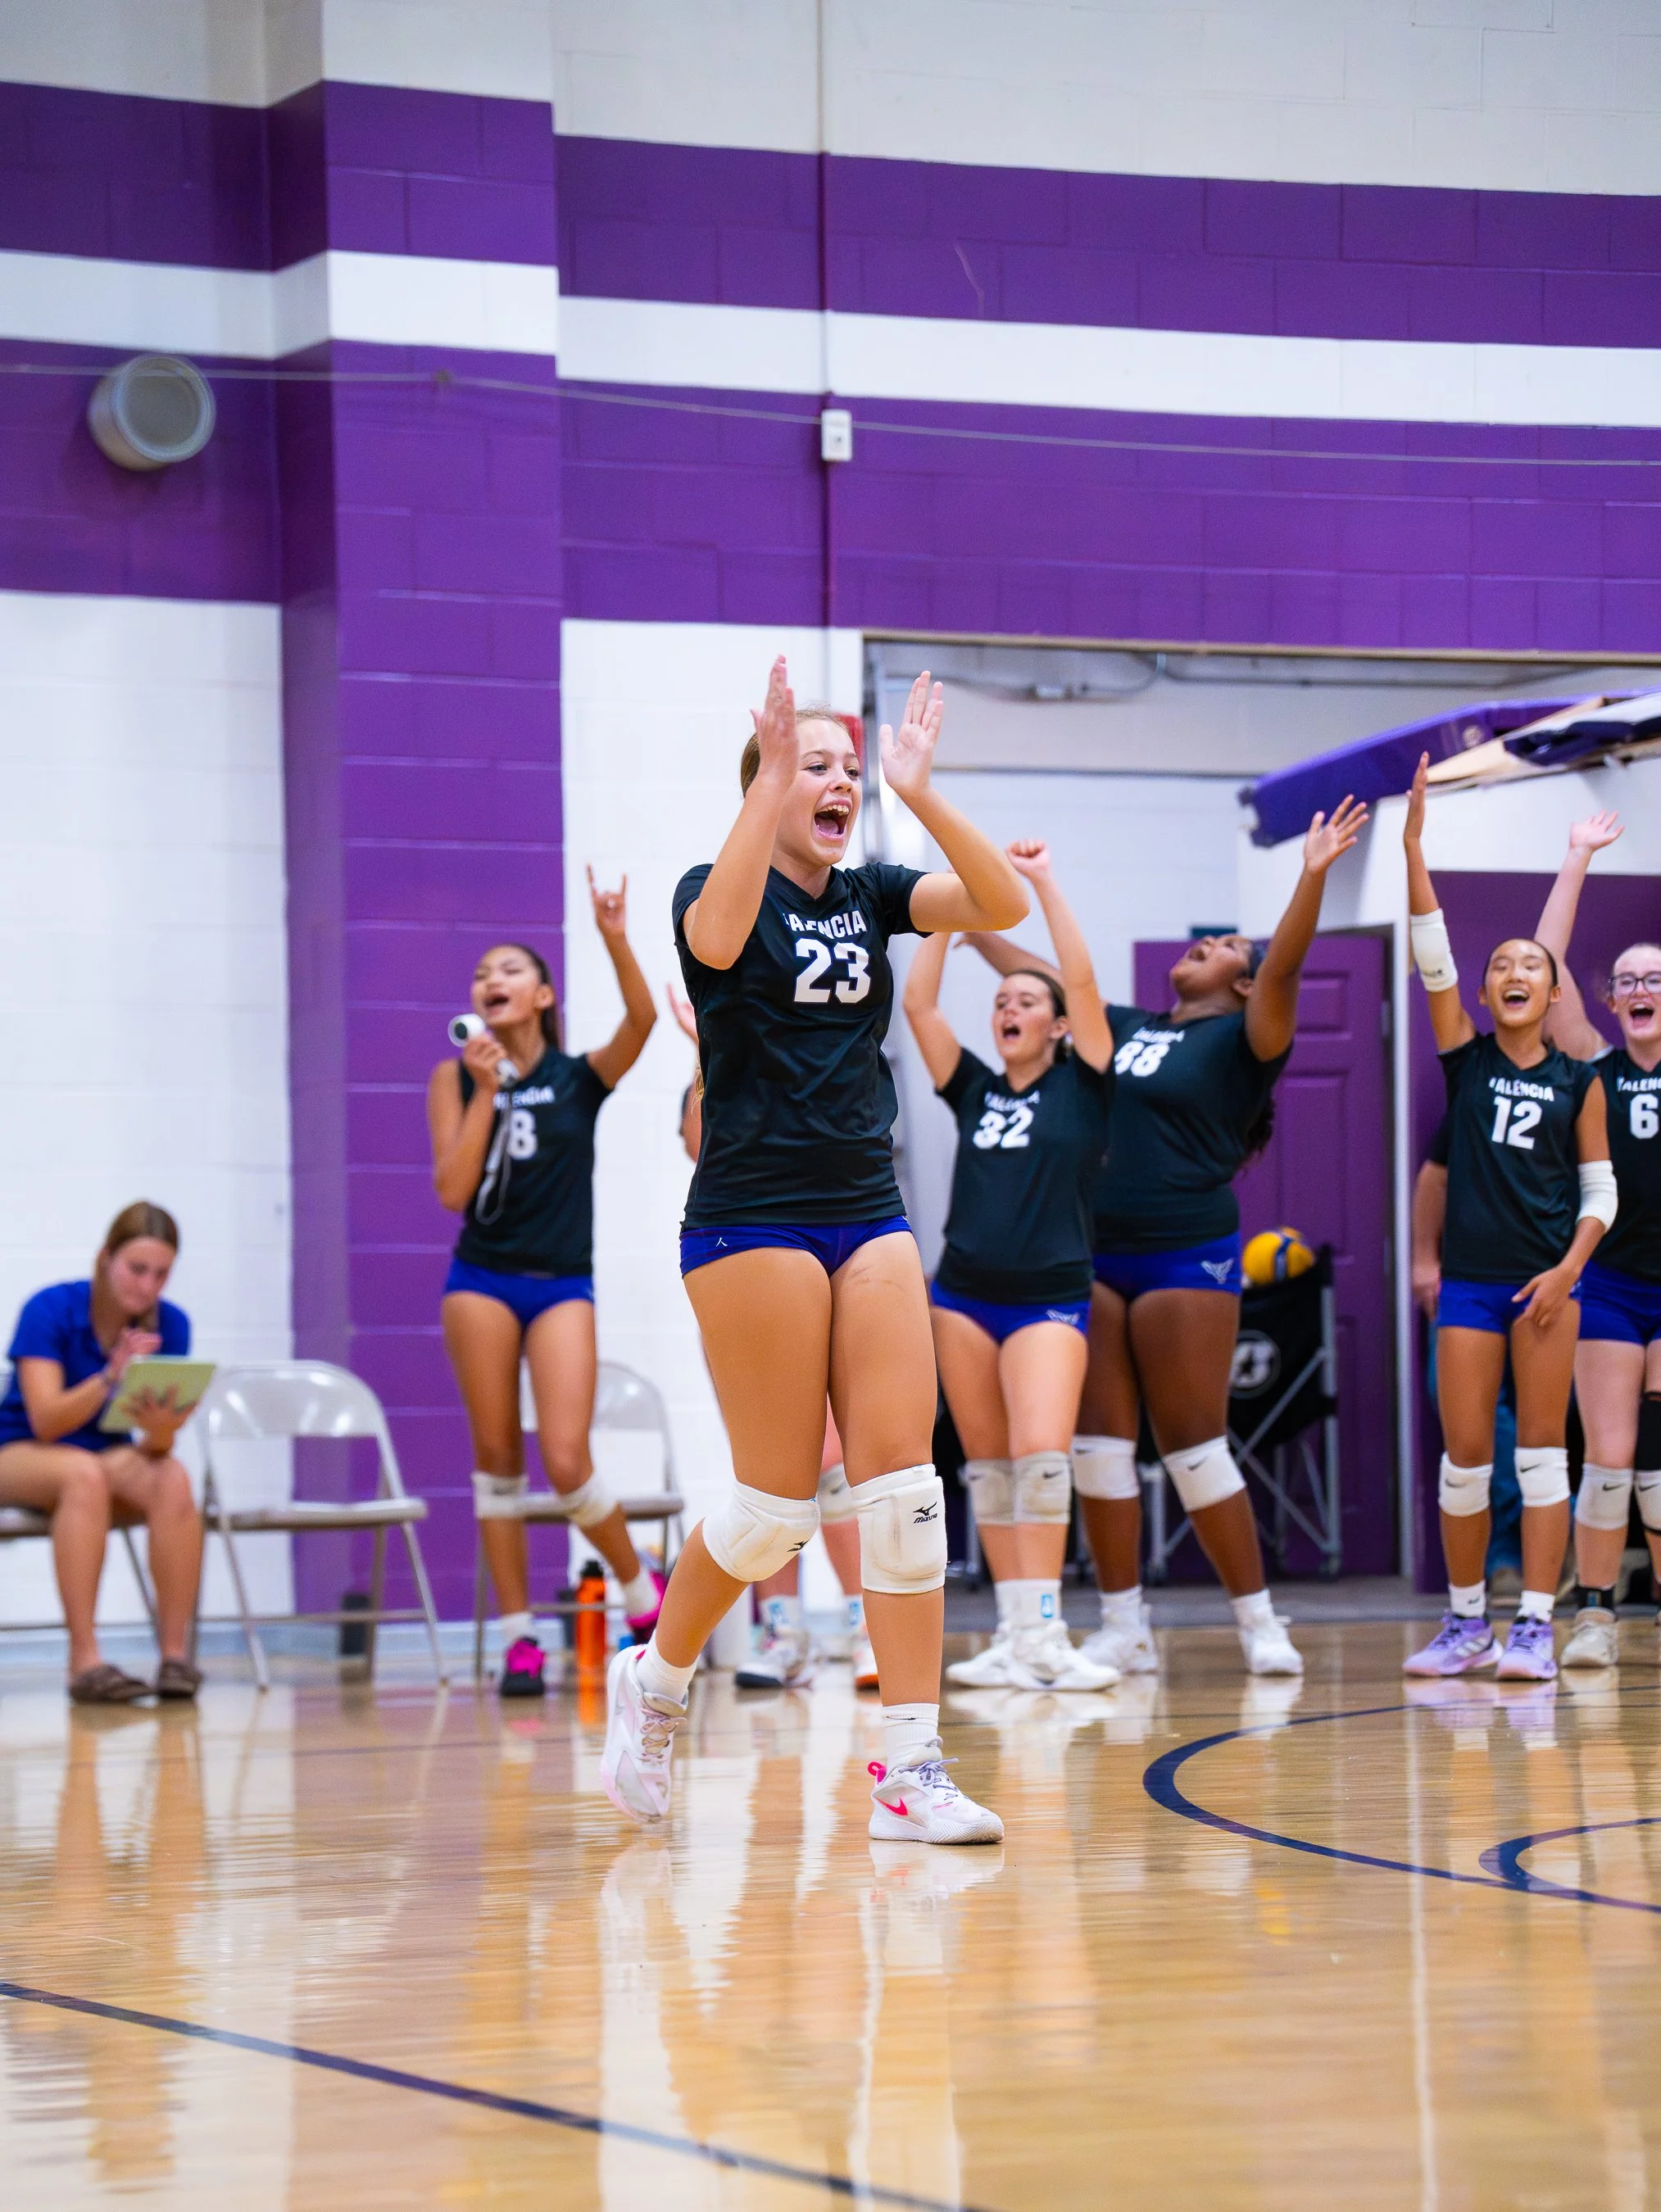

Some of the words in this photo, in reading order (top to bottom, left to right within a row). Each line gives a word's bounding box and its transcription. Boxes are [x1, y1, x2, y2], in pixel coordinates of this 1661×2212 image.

[783, 910, 867, 940] AENCIA
[793, 937, 871, 1004] 23
[507, 1108, 538, 1160] 8
[973, 1105, 1034, 1149] 32
[1491, 1095, 1542, 1150] 12
[1631, 1092, 1659, 1140] 6
